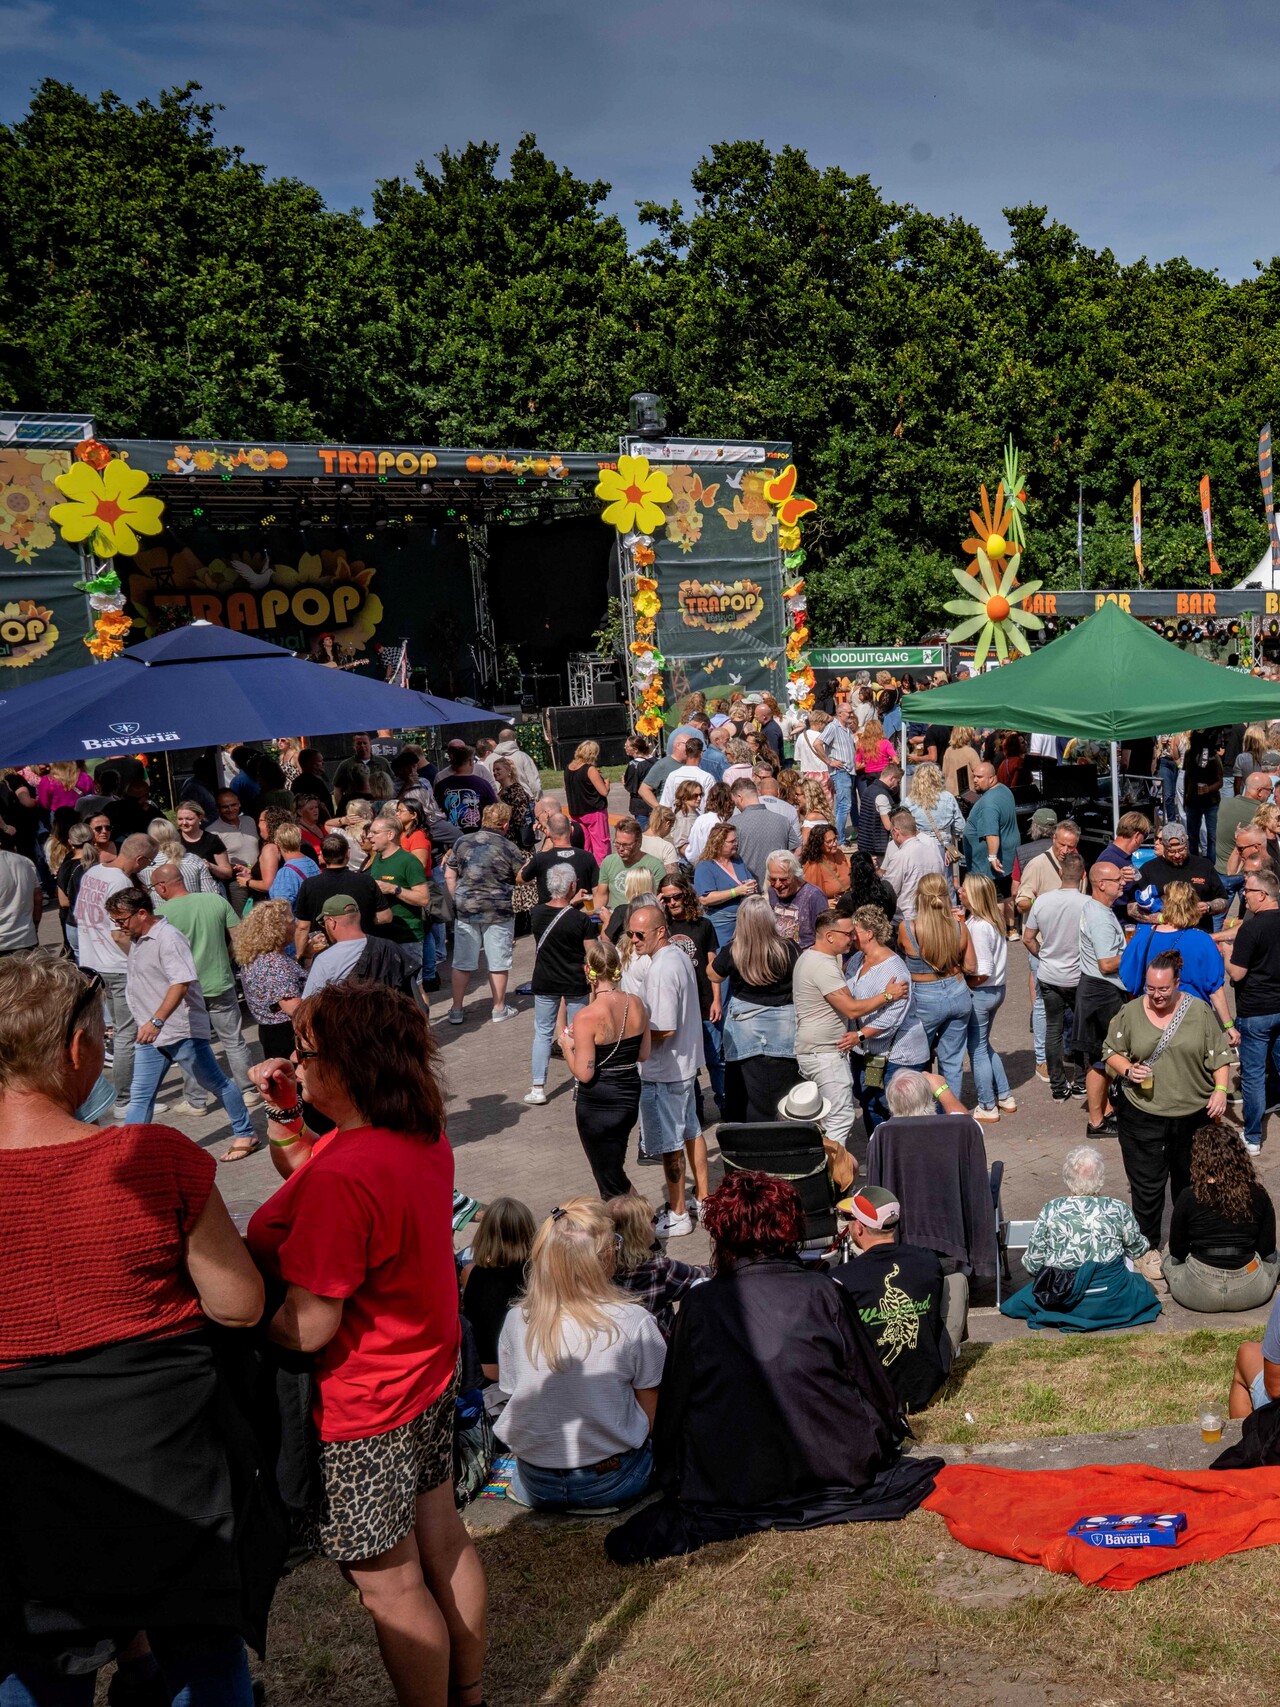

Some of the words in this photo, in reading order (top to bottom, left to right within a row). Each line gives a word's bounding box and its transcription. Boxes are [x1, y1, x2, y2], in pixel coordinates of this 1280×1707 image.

[318, 450, 437, 475] TRAPOP
[685, 593, 756, 614] TRAPOP
[1022, 593, 1057, 614] BAR
[1176, 593, 1217, 614] BAR
[822, 652, 909, 663] NOODUITGANG
[81, 732, 180, 750] Bavaria
[1105, 1533, 1150, 1545] Bavaria
